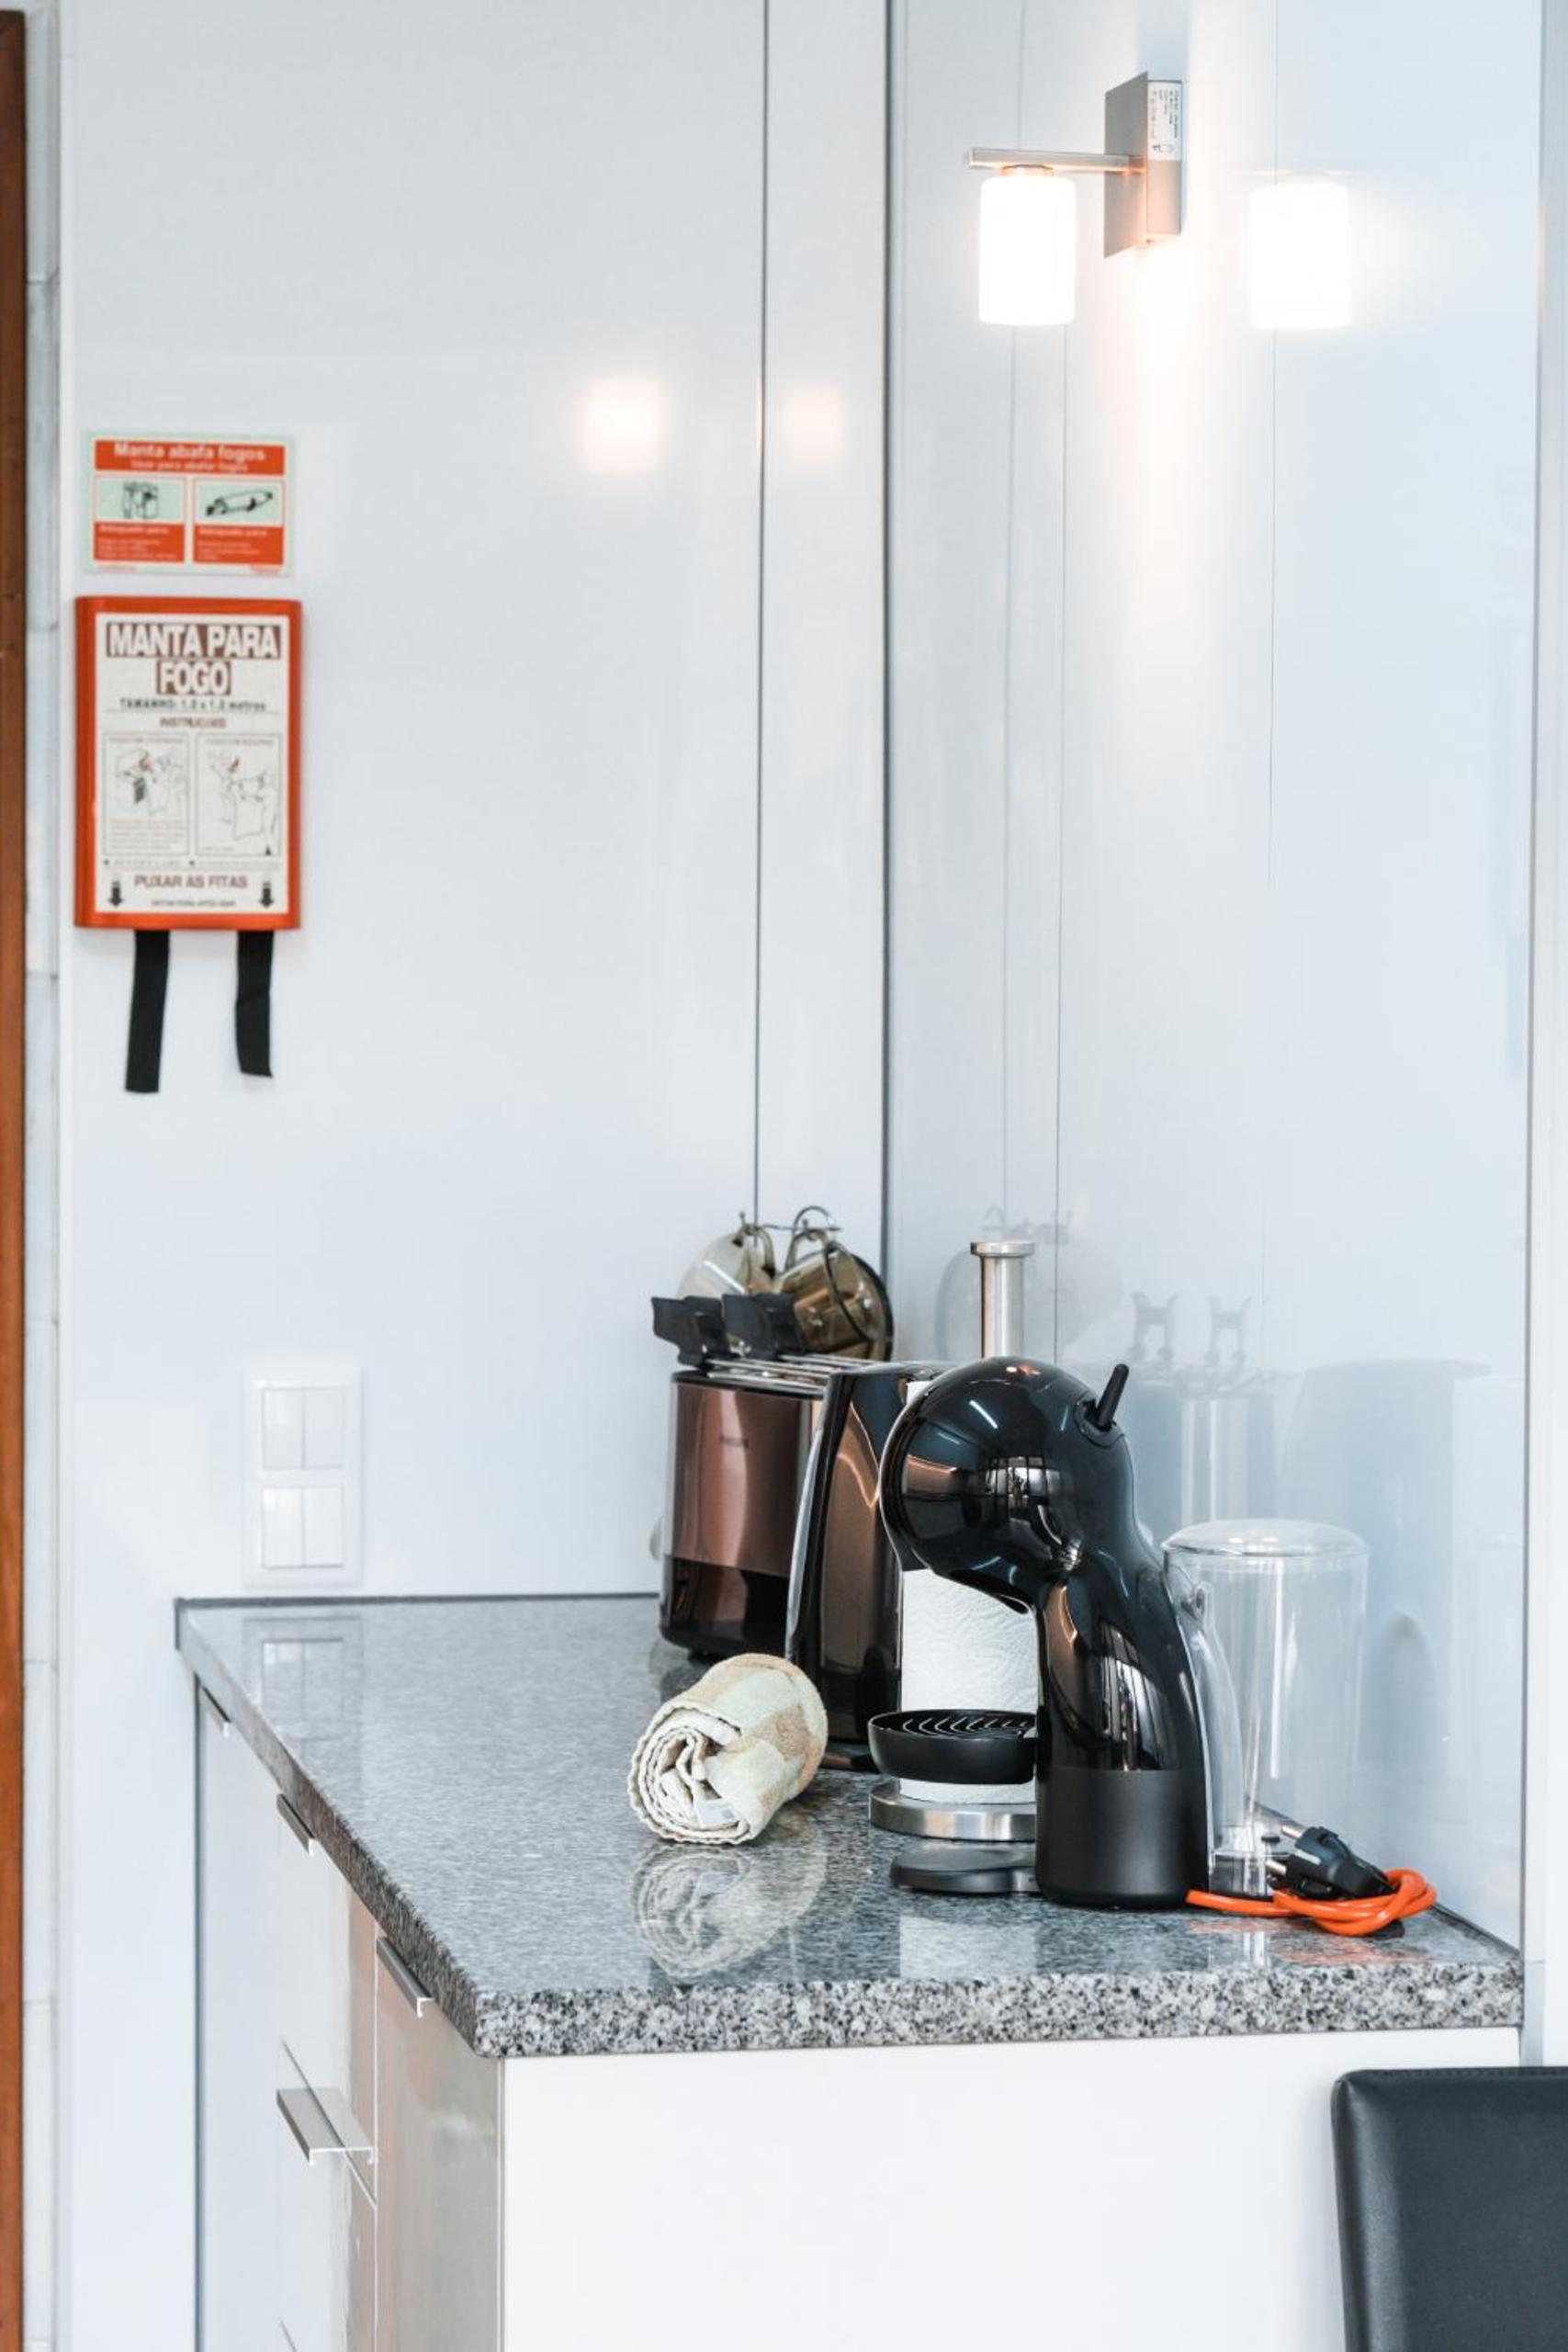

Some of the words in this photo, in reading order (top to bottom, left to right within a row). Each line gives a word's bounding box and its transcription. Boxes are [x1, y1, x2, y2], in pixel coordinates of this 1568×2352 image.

[114, 442, 164, 458] Manta
[168, 445, 213, 459] abafa
[219, 445, 265, 464] fogos
[109, 623, 202, 658] MANTA
[207, 626, 278, 660] PARA
[160, 661, 229, 695] FOGO
[134, 875, 183, 888] PUXAR
[186, 876, 204, 888] AS
[209, 876, 248, 888] FITAS
